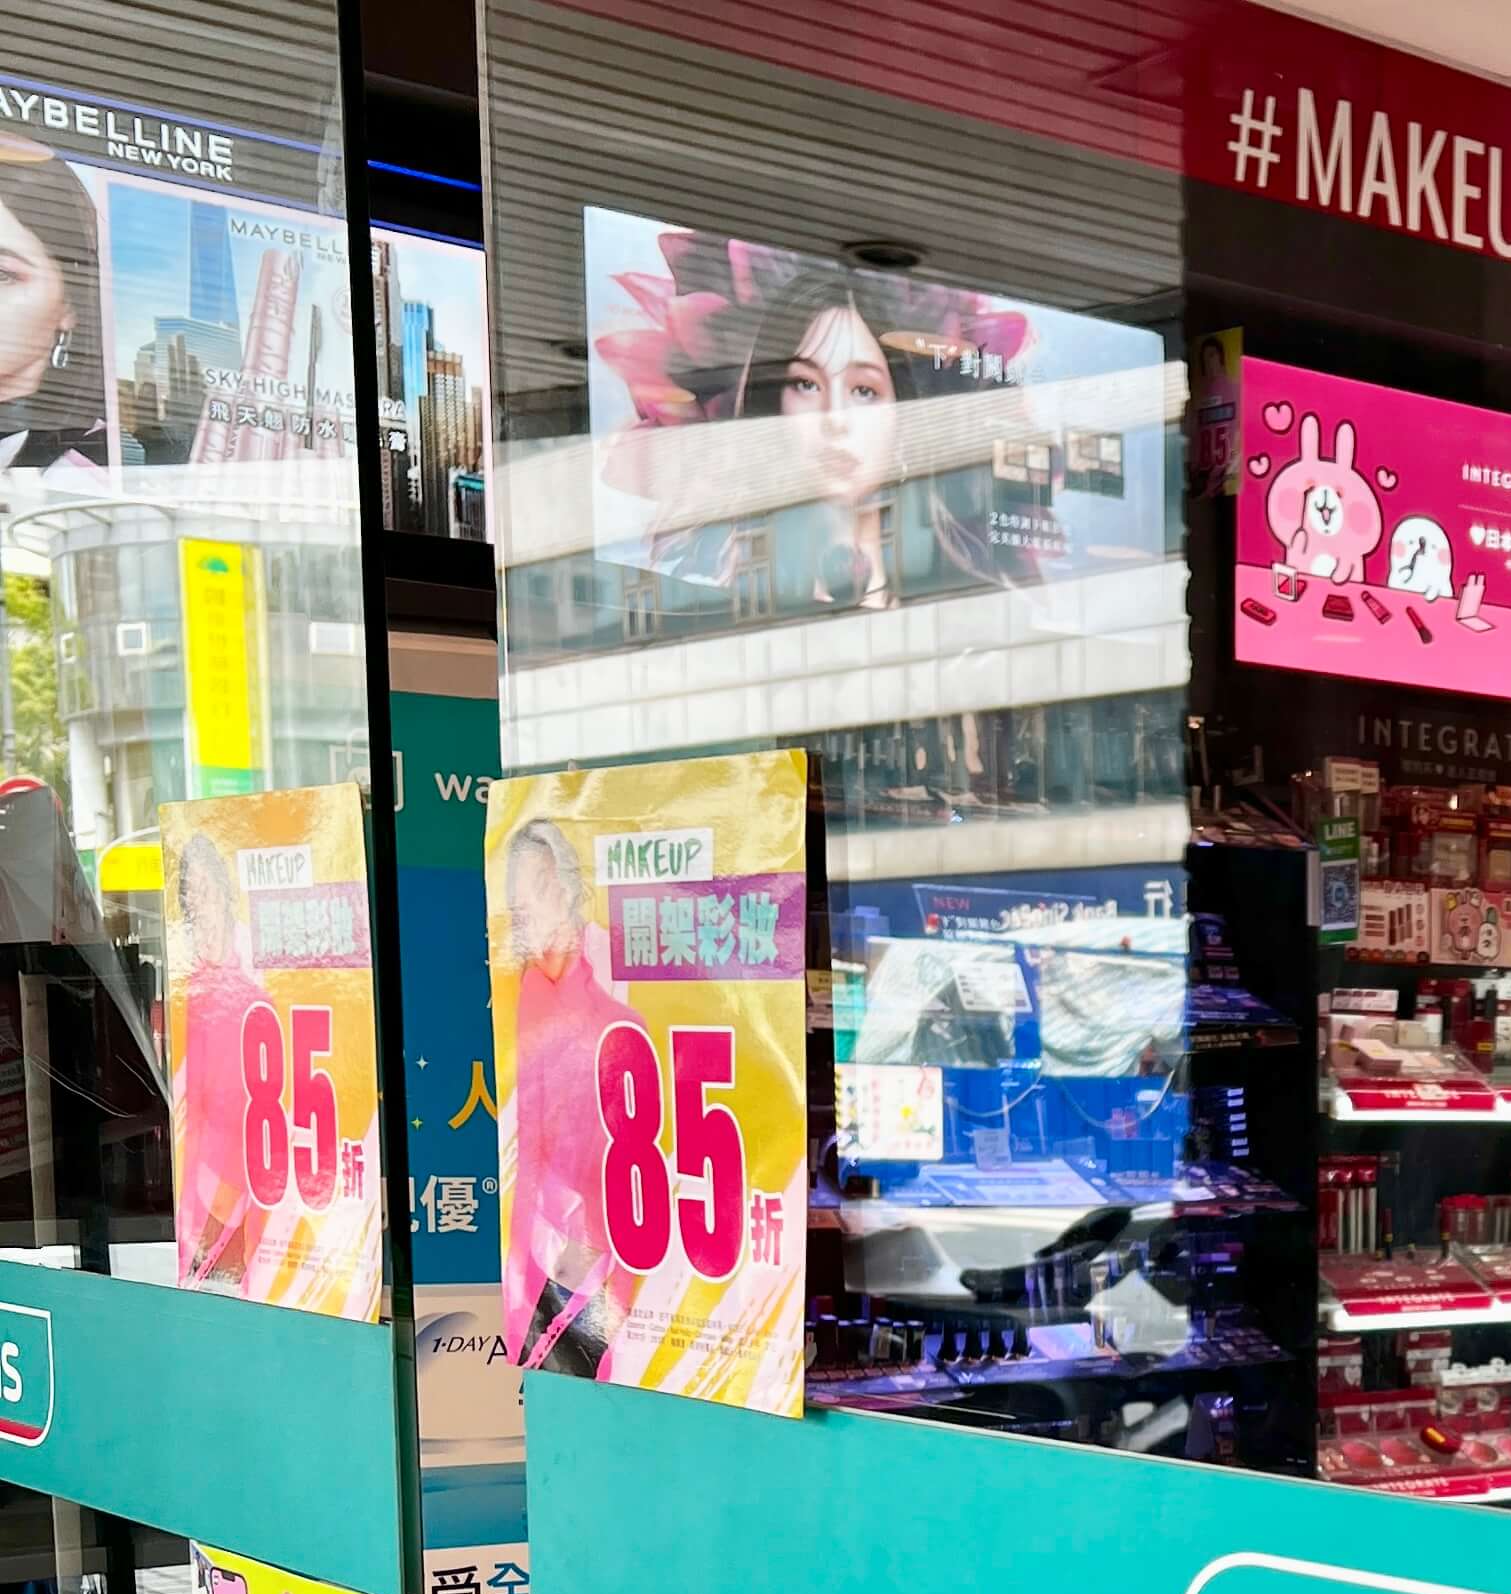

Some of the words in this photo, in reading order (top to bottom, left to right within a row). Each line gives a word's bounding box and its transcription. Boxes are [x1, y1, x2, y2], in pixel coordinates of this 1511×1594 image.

[108, 140, 163, 167] NEW
[167, 153, 233, 182] YORK
[205, 367, 246, 389] SKY
[315, 386, 408, 418] MASRA
[1323, 820, 1356, 840] LINE
[607, 837, 702, 880] MAKEUP
[621, 891, 780, 968] 開架彩妝
[241, 1001, 340, 1212] 85
[341, 1141, 365, 1200] 折
[598, 1021, 745, 1283] 85
[750, 1192, 785, 1266] 折
